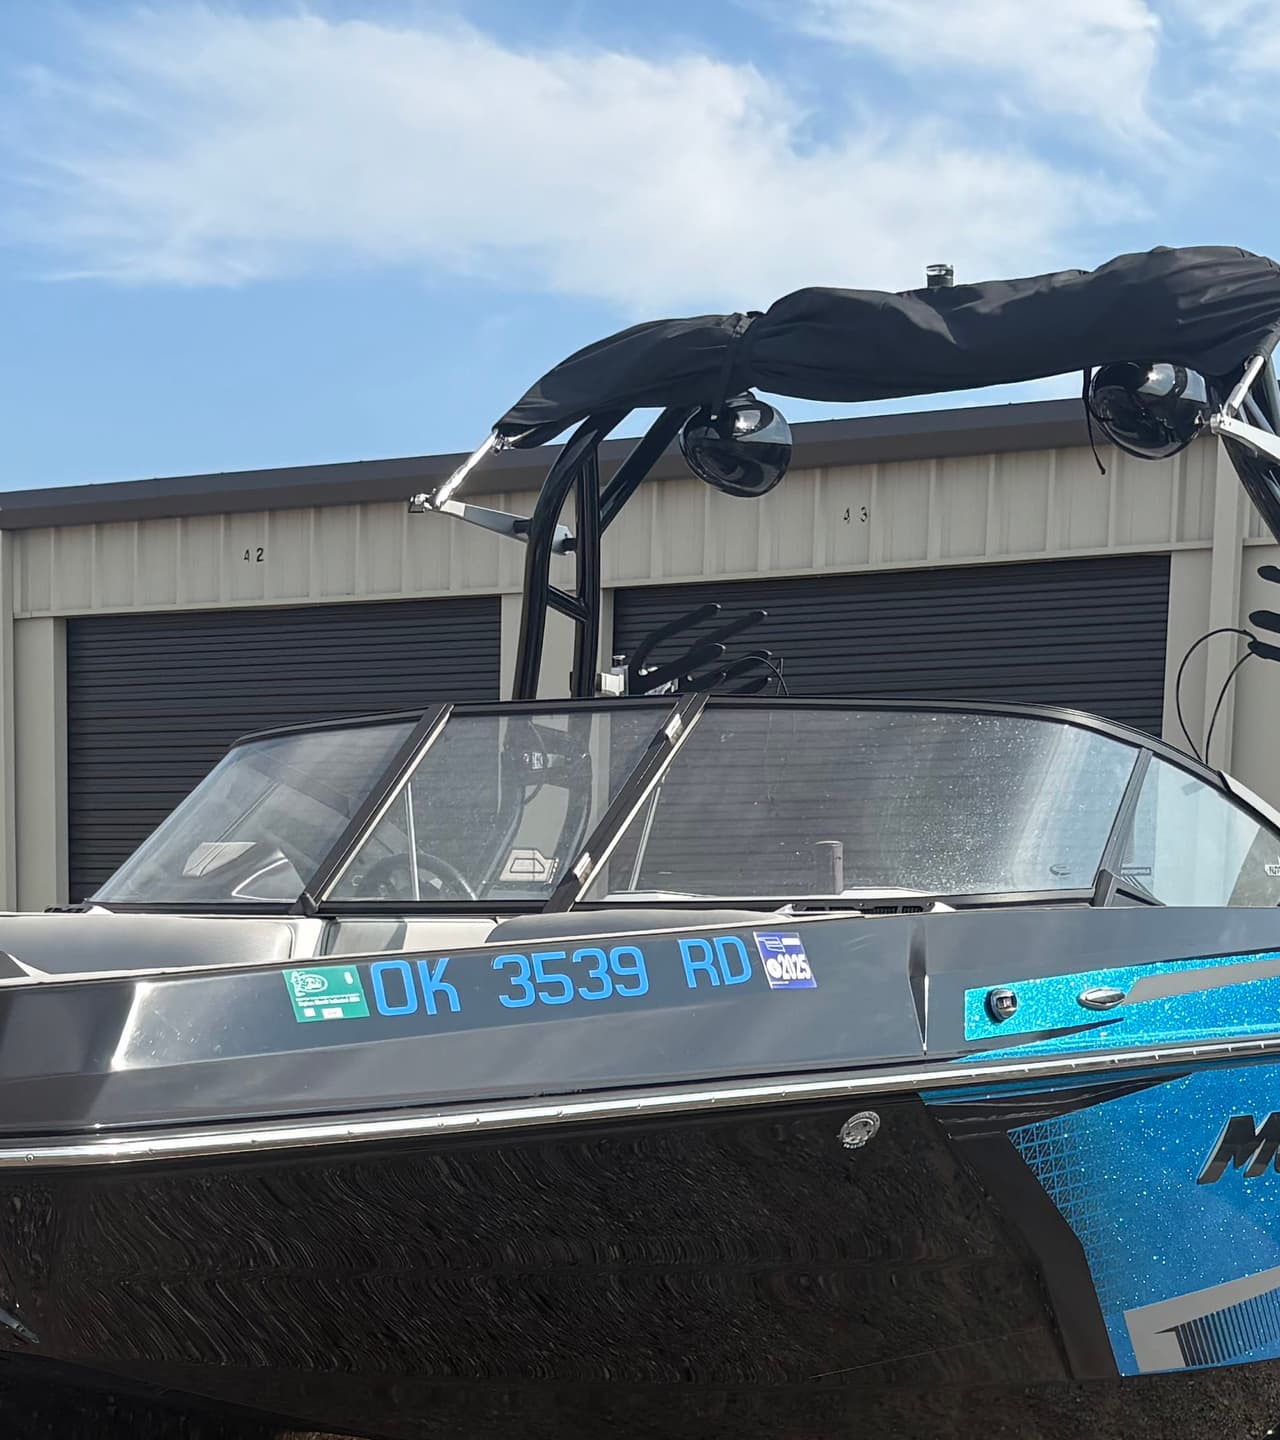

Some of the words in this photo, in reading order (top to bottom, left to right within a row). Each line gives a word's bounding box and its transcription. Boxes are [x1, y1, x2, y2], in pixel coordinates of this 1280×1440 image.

[243, 547, 265, 562] 42
[369, 957, 462, 1017] OK
[491, 945, 651, 1009] 3539
[677, 935, 753, 989] RD
